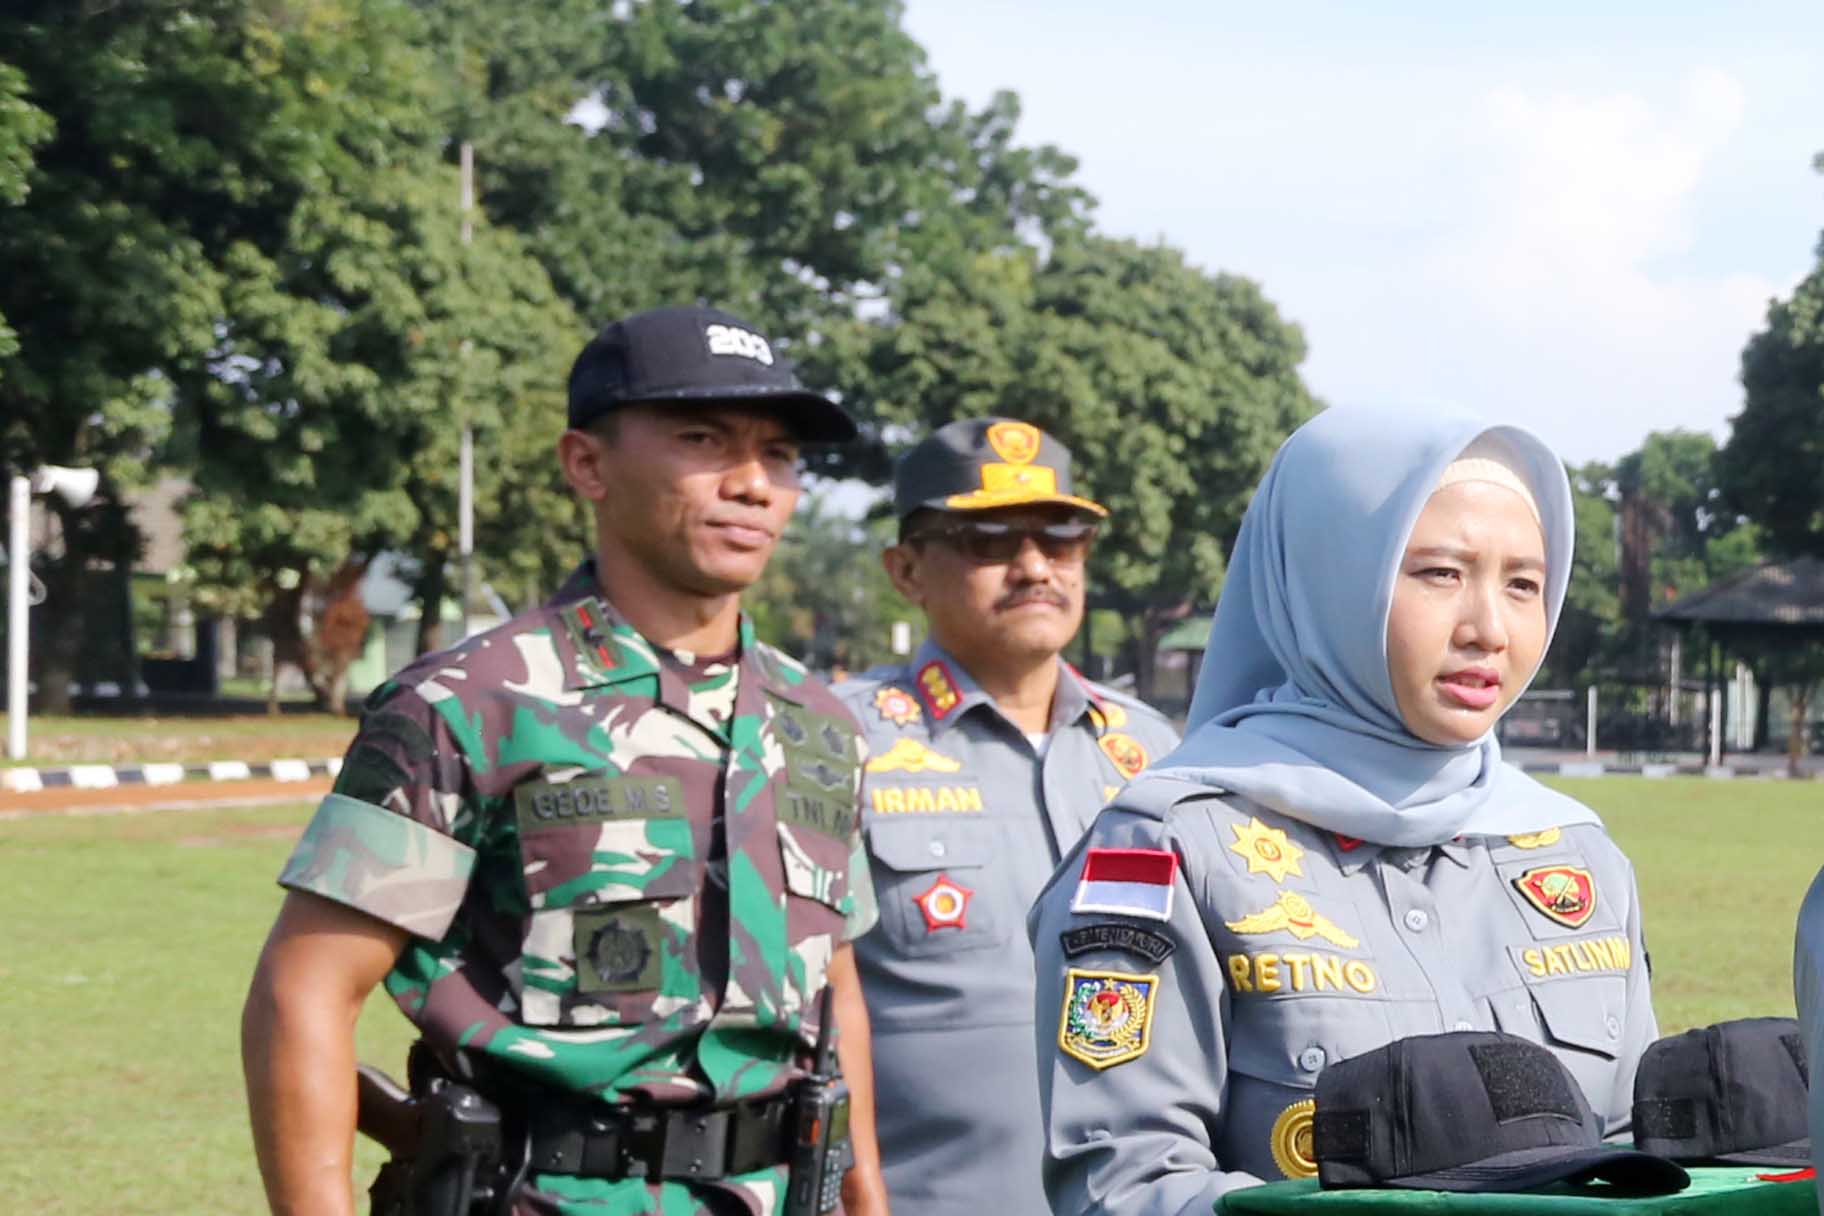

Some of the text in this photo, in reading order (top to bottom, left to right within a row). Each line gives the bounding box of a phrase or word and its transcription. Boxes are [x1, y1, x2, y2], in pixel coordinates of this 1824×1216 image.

[706, 325, 773, 366] 203
[655, 785, 672, 812] S
[872, 786, 983, 814] IRMAN
[1228, 952, 1377, 993] RETNO
